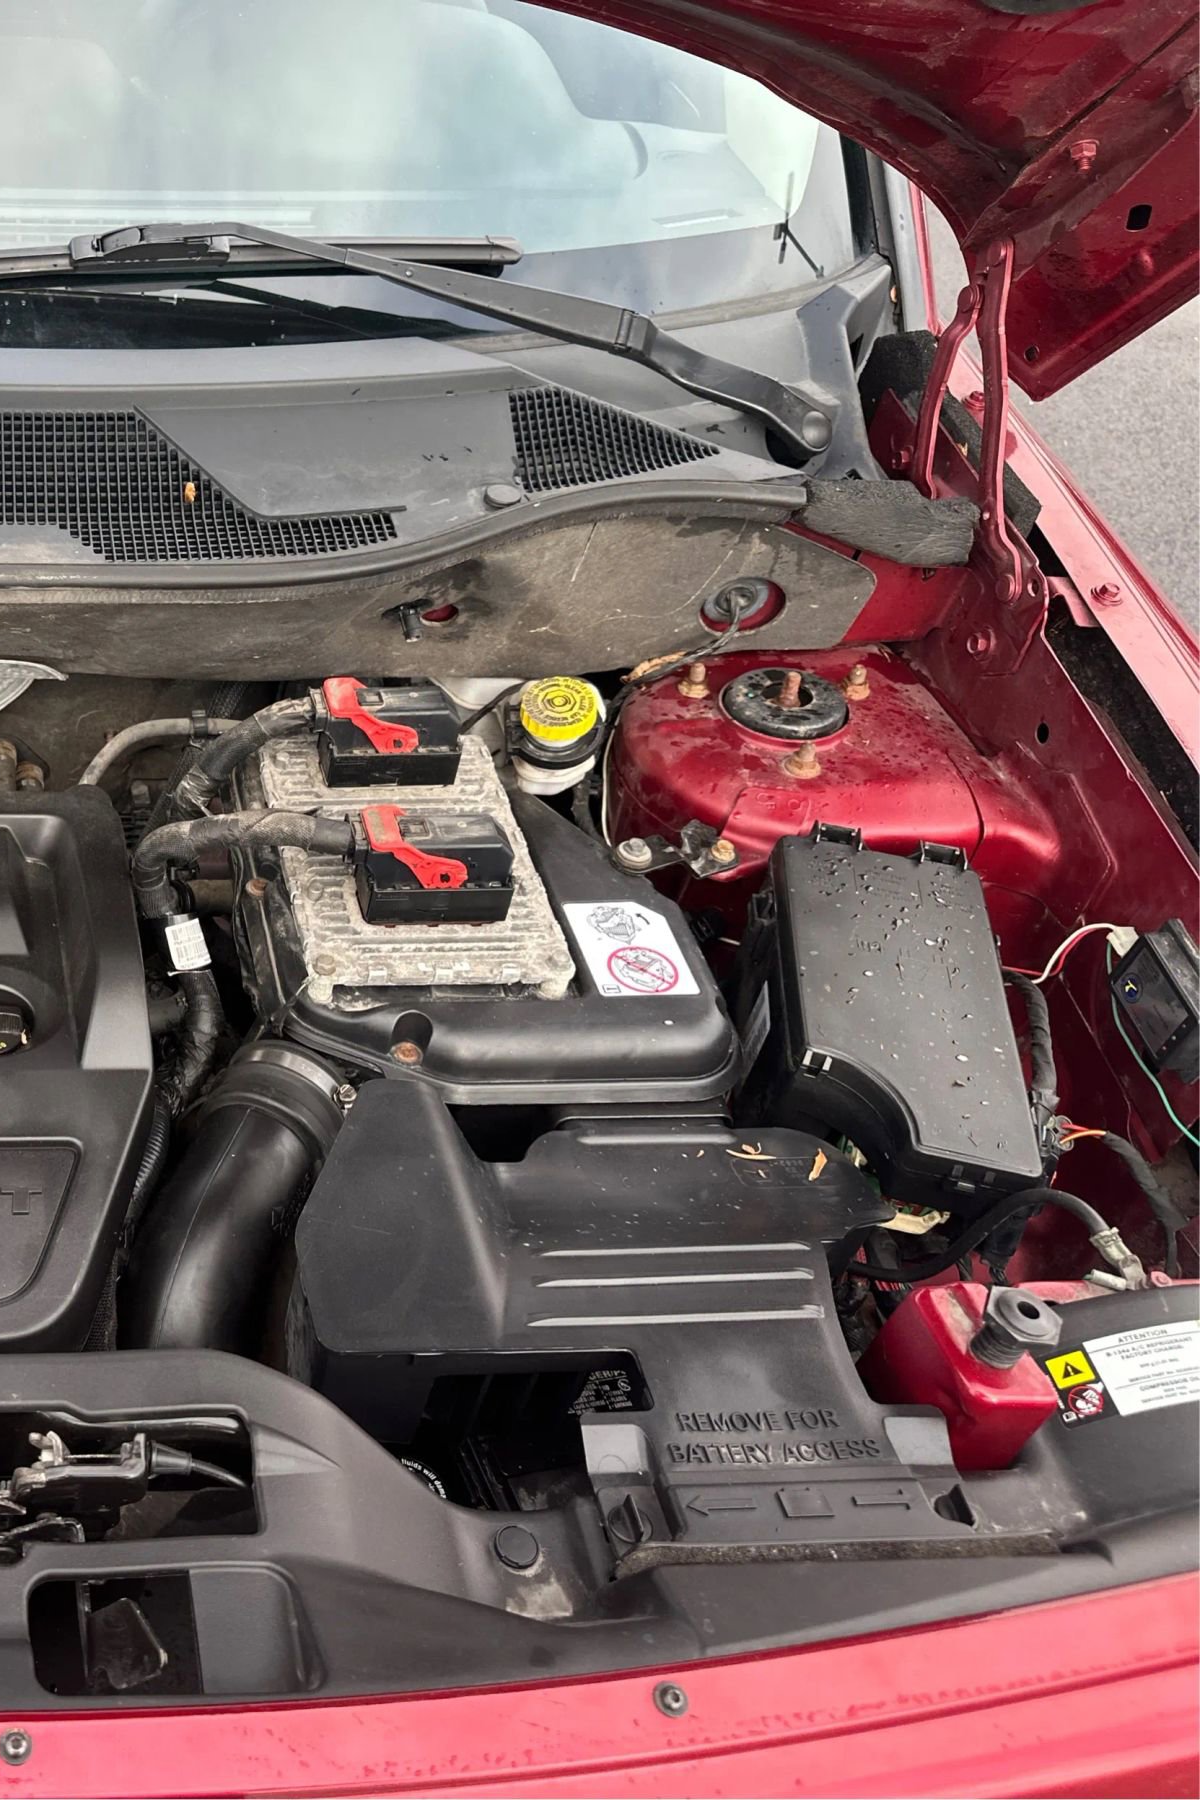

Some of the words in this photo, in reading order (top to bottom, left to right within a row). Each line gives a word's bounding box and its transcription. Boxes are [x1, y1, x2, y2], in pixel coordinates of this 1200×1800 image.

[1118, 1329, 1167, 1343] ATTENTION
[675, 1409, 784, 1434] REMOVE
[785, 1407, 840, 1430] FOR
[666, 1442, 774, 1465] BATTERY
[783, 1437, 881, 1464] ACCESS
[423, 1468, 437, 1480] will
